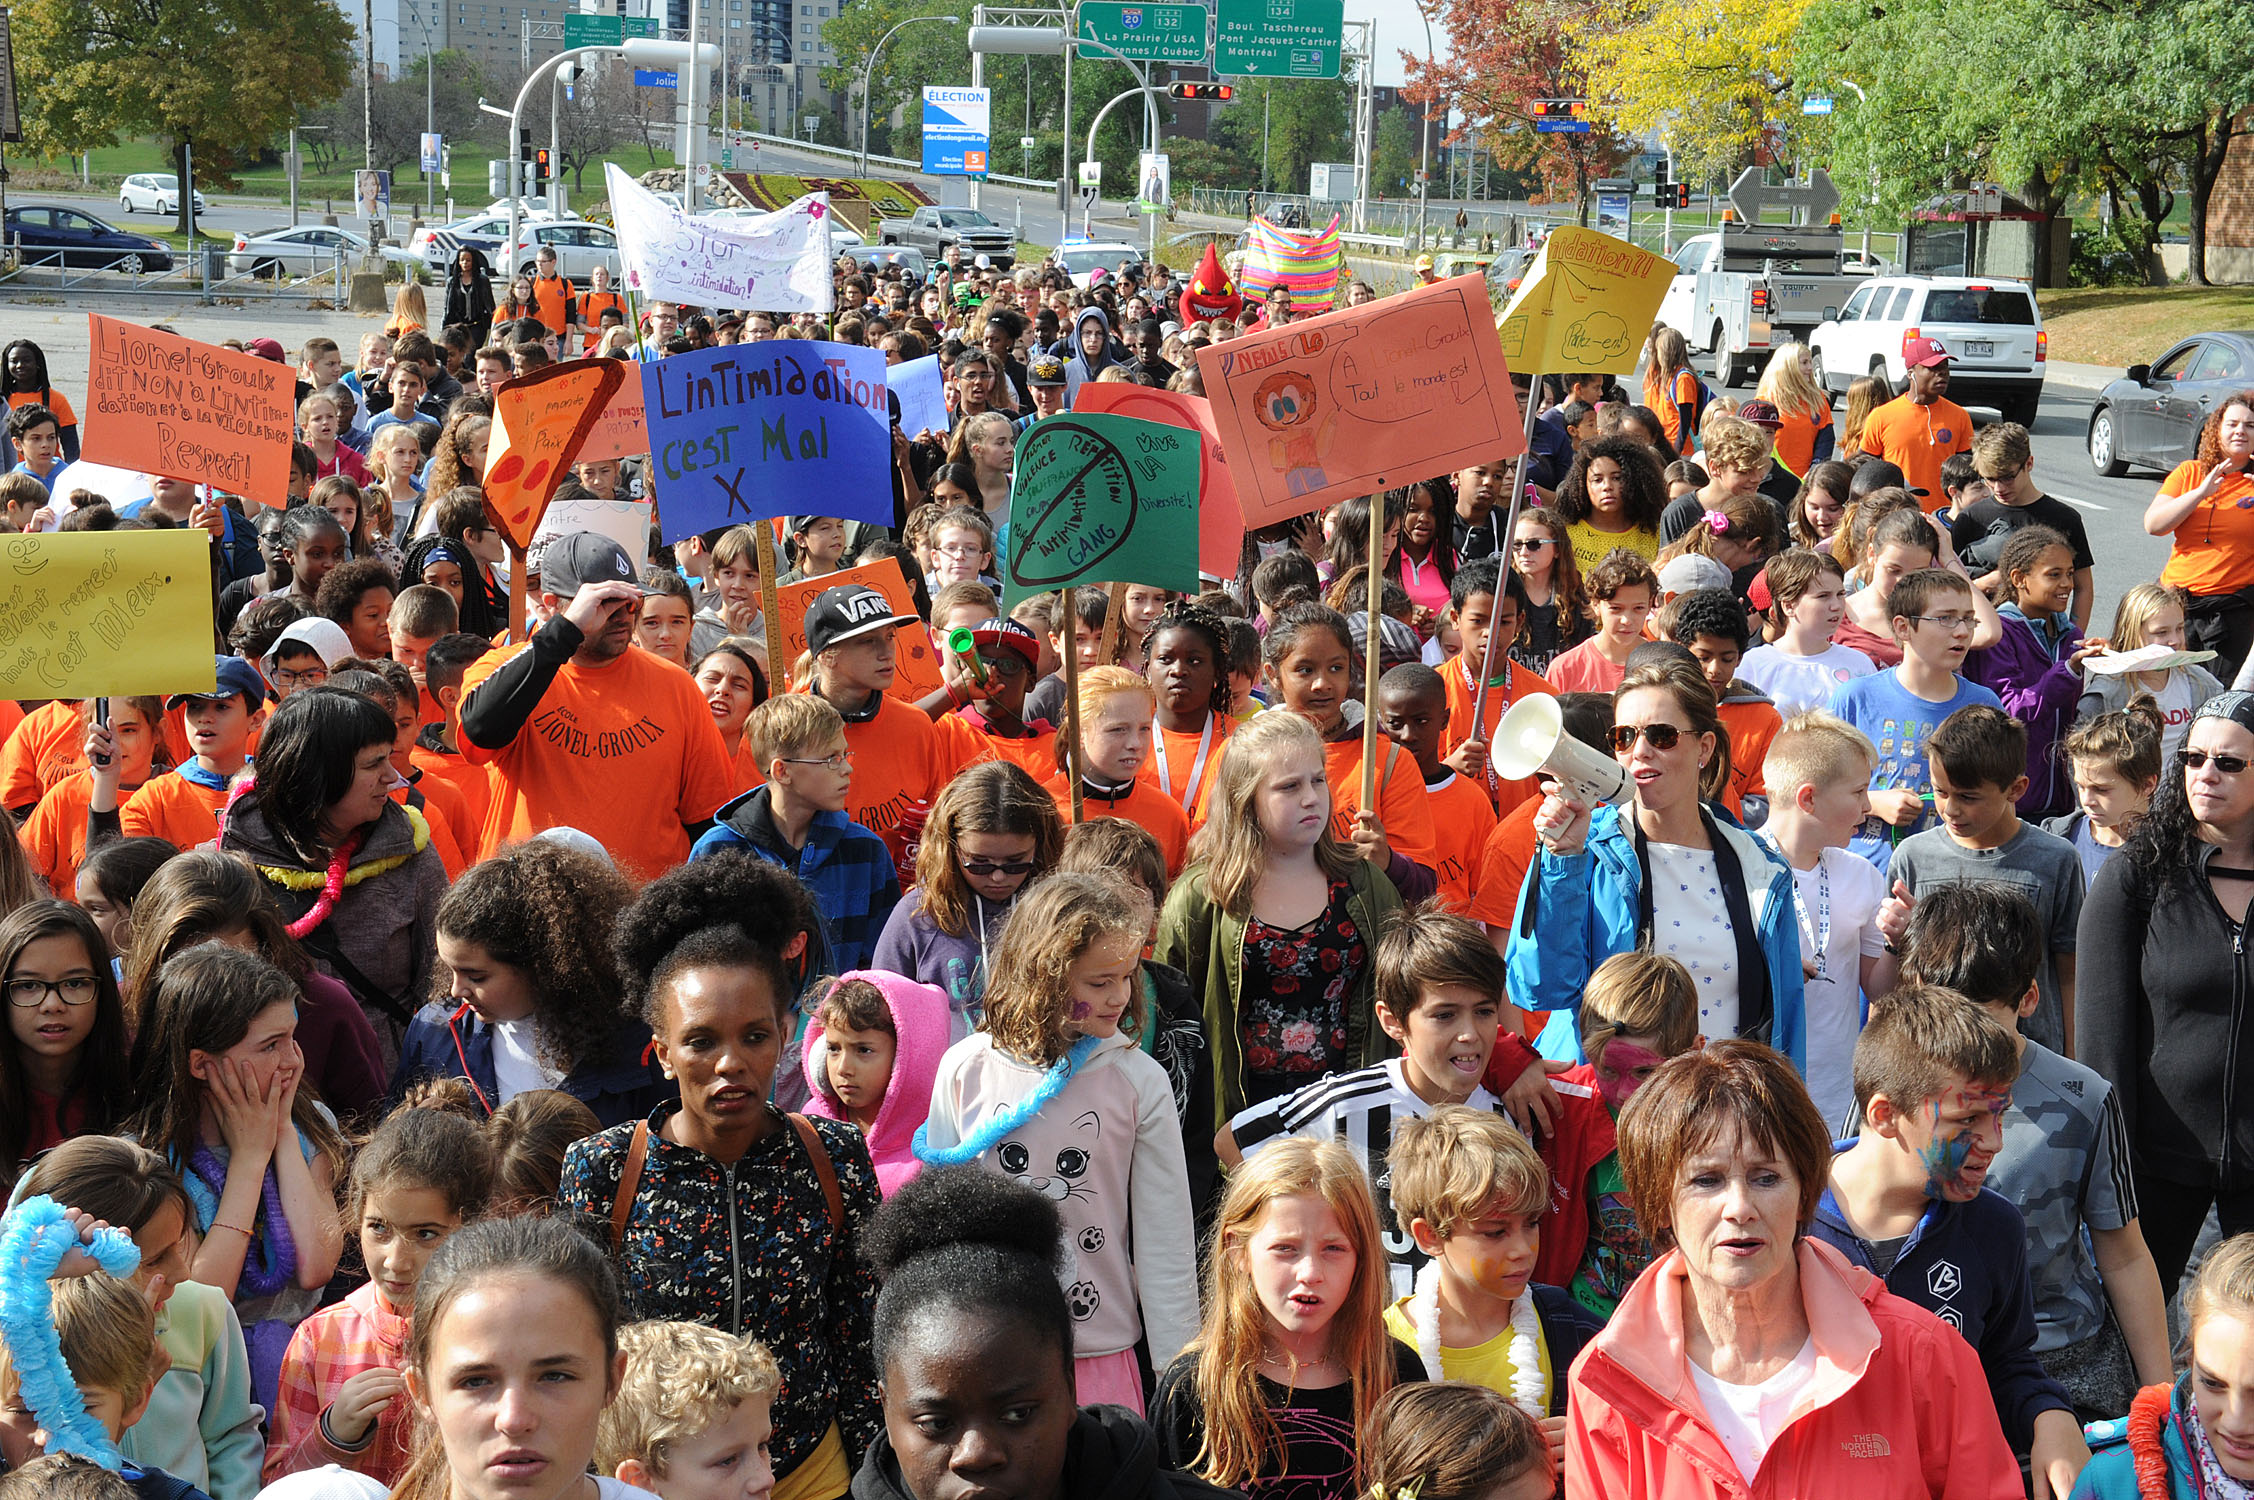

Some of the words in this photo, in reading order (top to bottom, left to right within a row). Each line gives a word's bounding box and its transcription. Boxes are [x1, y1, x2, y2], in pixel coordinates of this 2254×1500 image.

[1271, 7, 1290, 16] 134
[1124, 15, 1139, 24] 20
[1157, 17, 1178, 27] 132
[1262, 23, 1324, 33] Taschereau
[1105, 33, 1117, 41] La
[1123, 33, 1161, 43] Prairie
[1173, 34, 1196, 44] USA
[1219, 34, 1244, 43] Pont
[1251, 35, 1338, 47] Jacques-Cartier
[1162, 46, 1200, 57] Québec
[1228, 46, 1277, 57] Montréal
[928, 89, 984, 102] ÉLECTION
[971, 154, 979, 164] 5
[97, 316, 277, 391] Lionel-Groulx
[1237, 340, 1289, 374] NEWS
[1343, 351, 1358, 378] À
[133, 368, 183, 402] NON
[190, 380, 206, 402] à
[1345, 379, 1379, 404] Tout
[1394, 376, 1406, 393] le
[1413, 370, 1448, 389] monde
[1449, 356, 1468, 379] est
[97, 393, 157, 416] dation
[545, 395, 584, 414] monde
[761, 412, 829, 462] Mal
[157, 421, 251, 490] Respect!
[1067, 523, 1117, 568] GANG
[59, 547, 118, 616] respect
[836, 591, 894, 624] VANS
[1852, 1434, 1871, 1442] THE
[1841, 1442, 1873, 1451] NORTH
[1849, 1449, 1873, 1458] FACE
